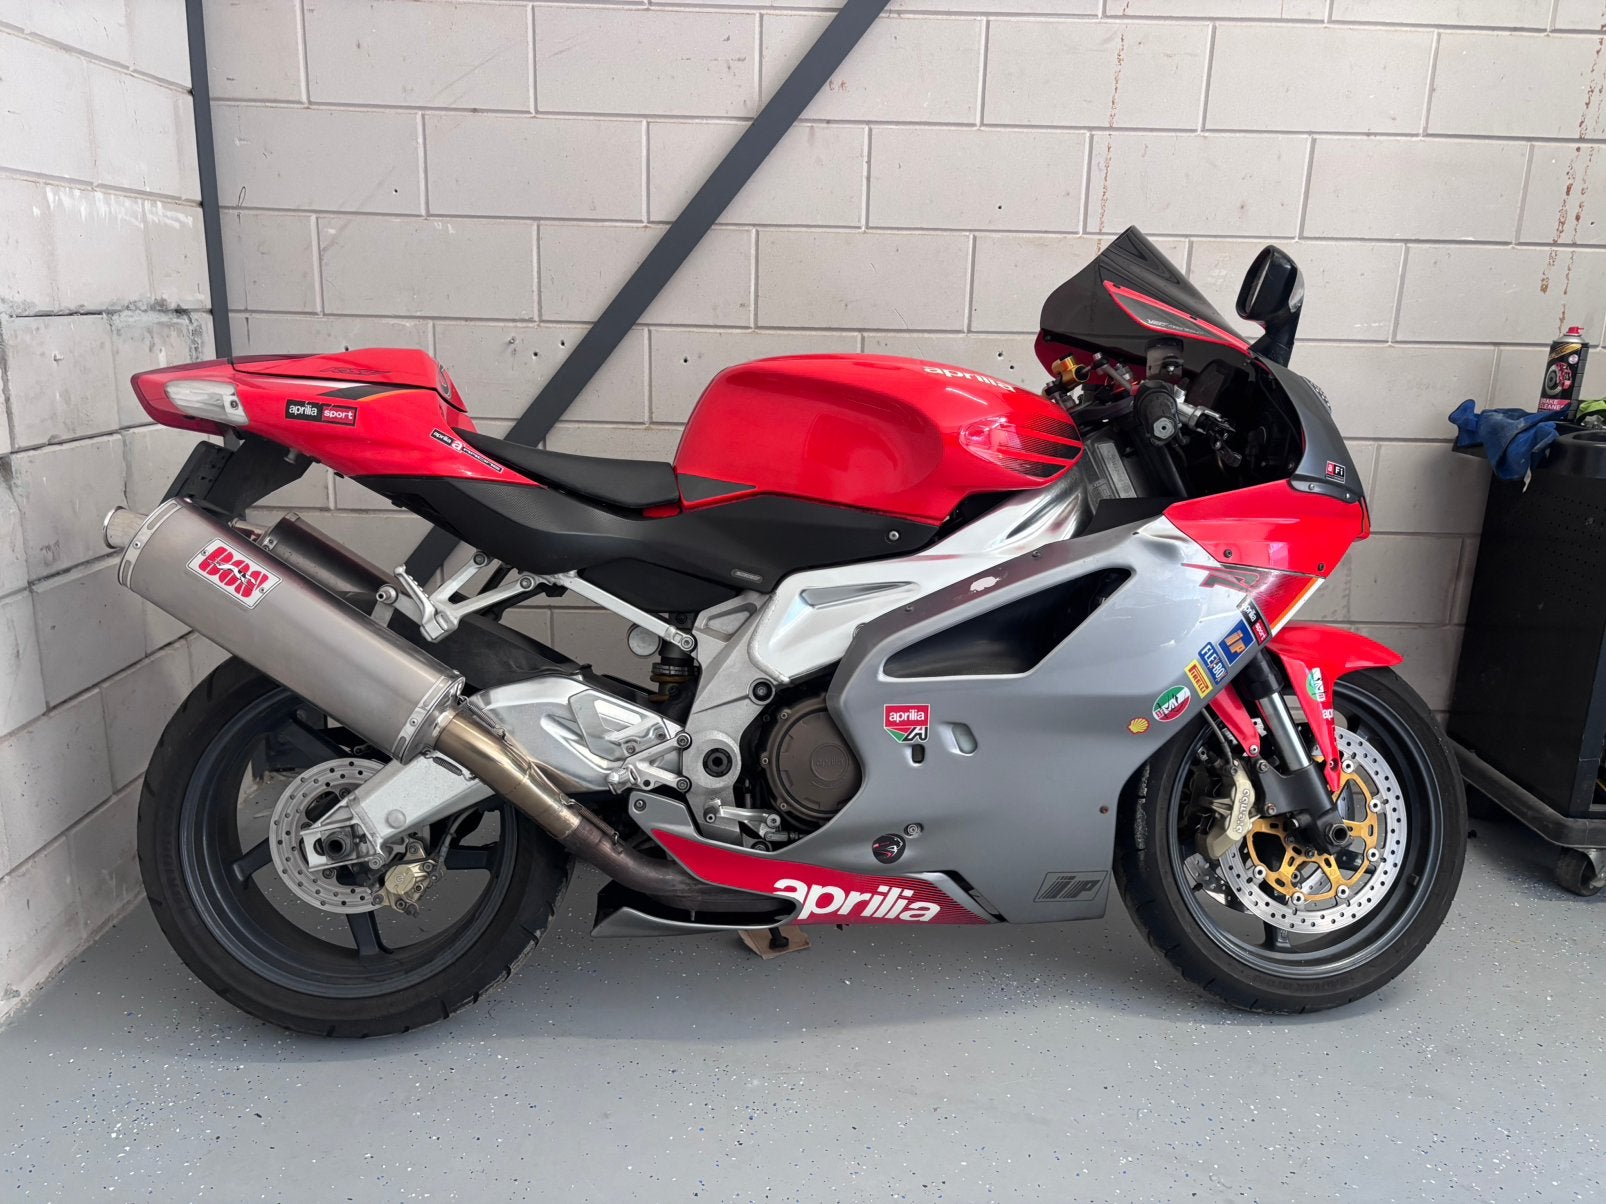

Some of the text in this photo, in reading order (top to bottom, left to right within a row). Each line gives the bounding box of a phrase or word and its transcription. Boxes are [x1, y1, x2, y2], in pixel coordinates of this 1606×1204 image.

[922, 366, 1016, 393] aprilia
[288, 404, 353, 420] aprilia sport
[1187, 663, 1210, 695] PIRELLI
[889, 709, 925, 723] aprilia
[773, 878, 941, 922] aprilia
